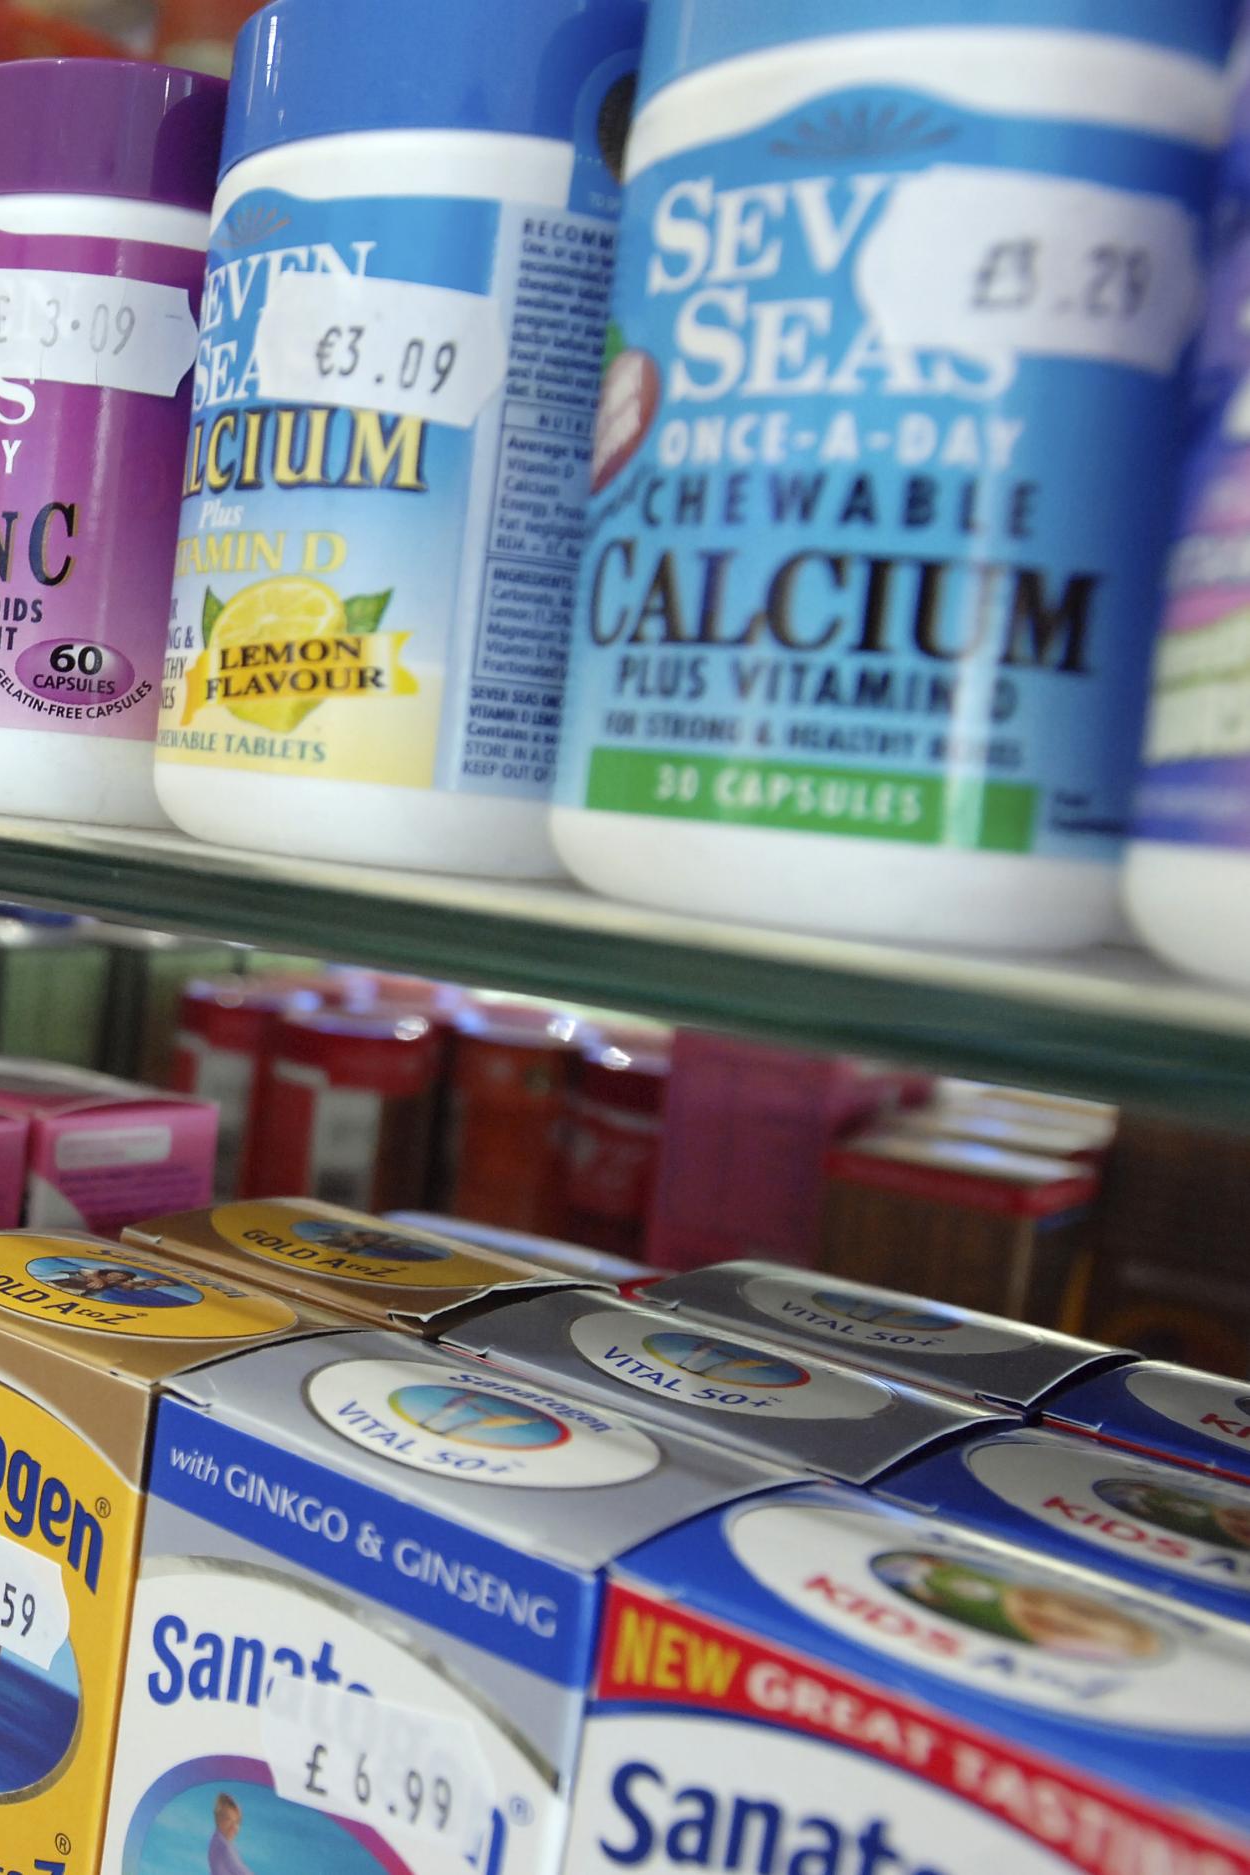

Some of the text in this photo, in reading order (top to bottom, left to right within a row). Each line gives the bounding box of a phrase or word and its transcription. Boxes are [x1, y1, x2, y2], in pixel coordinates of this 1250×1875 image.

[507, 434, 569, 460] Average
[658, 409, 1027, 472] ONCE-A-DAY
[504, 474, 560, 497] Calcium
[644, 468, 1041, 542] CHEWABLE
[199, 498, 245, 530] Plus
[28, 501, 81, 587] C
[301, 529, 349, 575] D
[589, 536, 1106, 678] CALCIUM
[49, 643, 104, 676] 60
[219, 635, 363, 672] LEMON
[32, 673, 116, 695] CAPSULES
[85, 679, 154, 720] CAPSULES
[205, 664, 388, 701] FLAVOUR
[613, 649, 709, 701] PLUS
[728, 656, 960, 721] VITAMIN
[224, 733, 328, 763] TABLETS
[656, 762, 926, 828] 30 CAPSULES
[241, 1227, 321, 1264] GOLD
[780, 1300, 857, 1338] VITAL
[601, 1344, 685, 1394] VITAL
[449, 1370, 612, 1435] Sanatogen
[335, 1399, 416, 1457] VITAL
[170, 1446, 559, 1639] with GINKGO & GINSENG
[1041, 1494, 1193, 1561] KIDS
[610, 1605, 742, 1700] NEW
[745, 1660, 941, 1770] GREAT
[303, 1742, 453, 1833] £6.99
